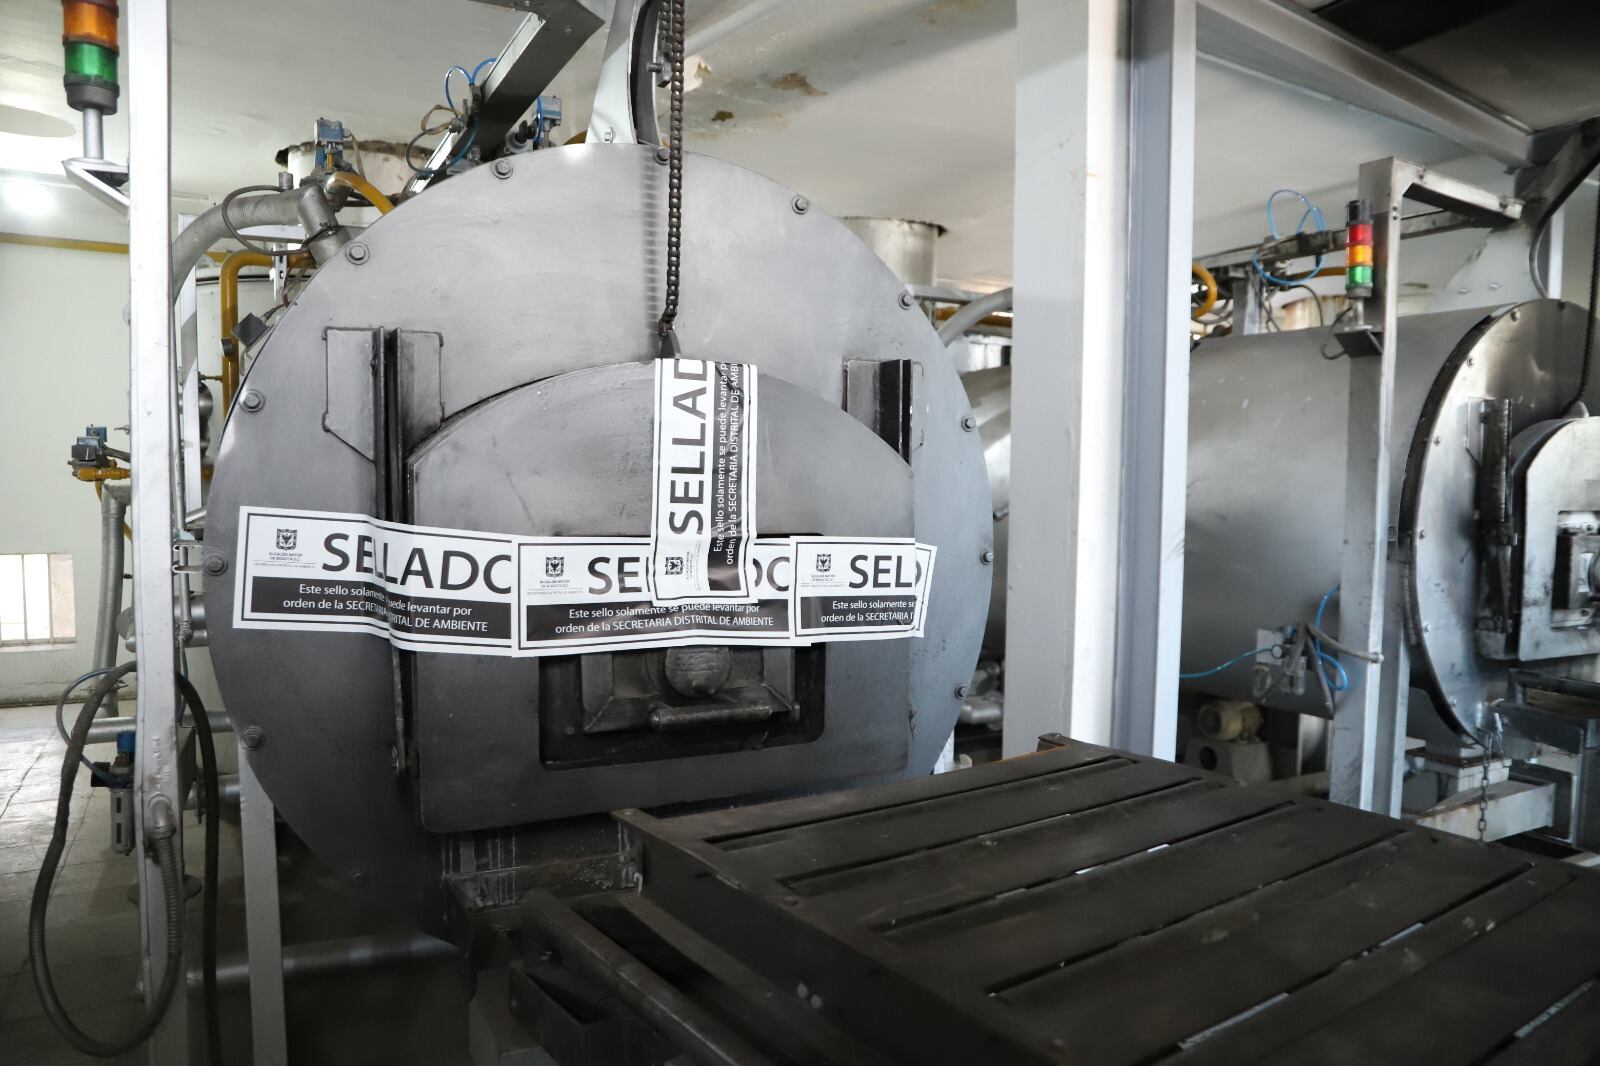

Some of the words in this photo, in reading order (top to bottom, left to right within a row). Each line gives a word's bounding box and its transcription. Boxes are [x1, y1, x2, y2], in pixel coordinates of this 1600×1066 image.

[718, 372, 728, 410] levantar
[730, 389, 740, 403] DE
[717, 412, 727, 443] puede
[730, 405, 739, 453] DISTRITAL
[720, 445, 726, 456] se
[716, 457, 726, 508] solamente
[728, 455, 738, 512] SECRETARIA
[715, 510, 724, 532] sello
[728, 514, 737, 523] la
[728, 524, 737, 537] de
[713, 534, 724, 551] Este
[726, 538, 737, 565] orden
[299, 583, 321, 594] Este
[324, 585, 348, 596] sello
[407, 601, 451, 614] levantar
[453, 607, 473, 617] por
[832, 600, 849, 610] Este
[850, 600, 868, 609] sello
[869, 600, 907, 609] solamente
[283, 598, 315, 608] orden
[318, 599, 332, 609] de
[334, 600, 344, 610] la
[415, 617, 431, 628] DE
[432, 618, 488, 632] AMBIENTE
[569, 608, 589, 619] Este
[591, 607, 614, 617] sello
[616, 605, 667, 616] solamente
[746, 605, 760, 615] por
[820, 613, 844, 622] orden
[845, 612, 856, 622] de
[857, 612, 864, 621] la
[865, 611, 909, 621] SECRETARIA
[555, 623, 585, 634] orden
[587, 622, 600, 632] de
[602, 620, 611, 631] la
[613, 617, 672, 631] SECRETARIA
[675, 615, 717, 626] DISTRITAL
[719, 615, 731, 626] DE
[732, 616, 774, 627] AMBIENTE
